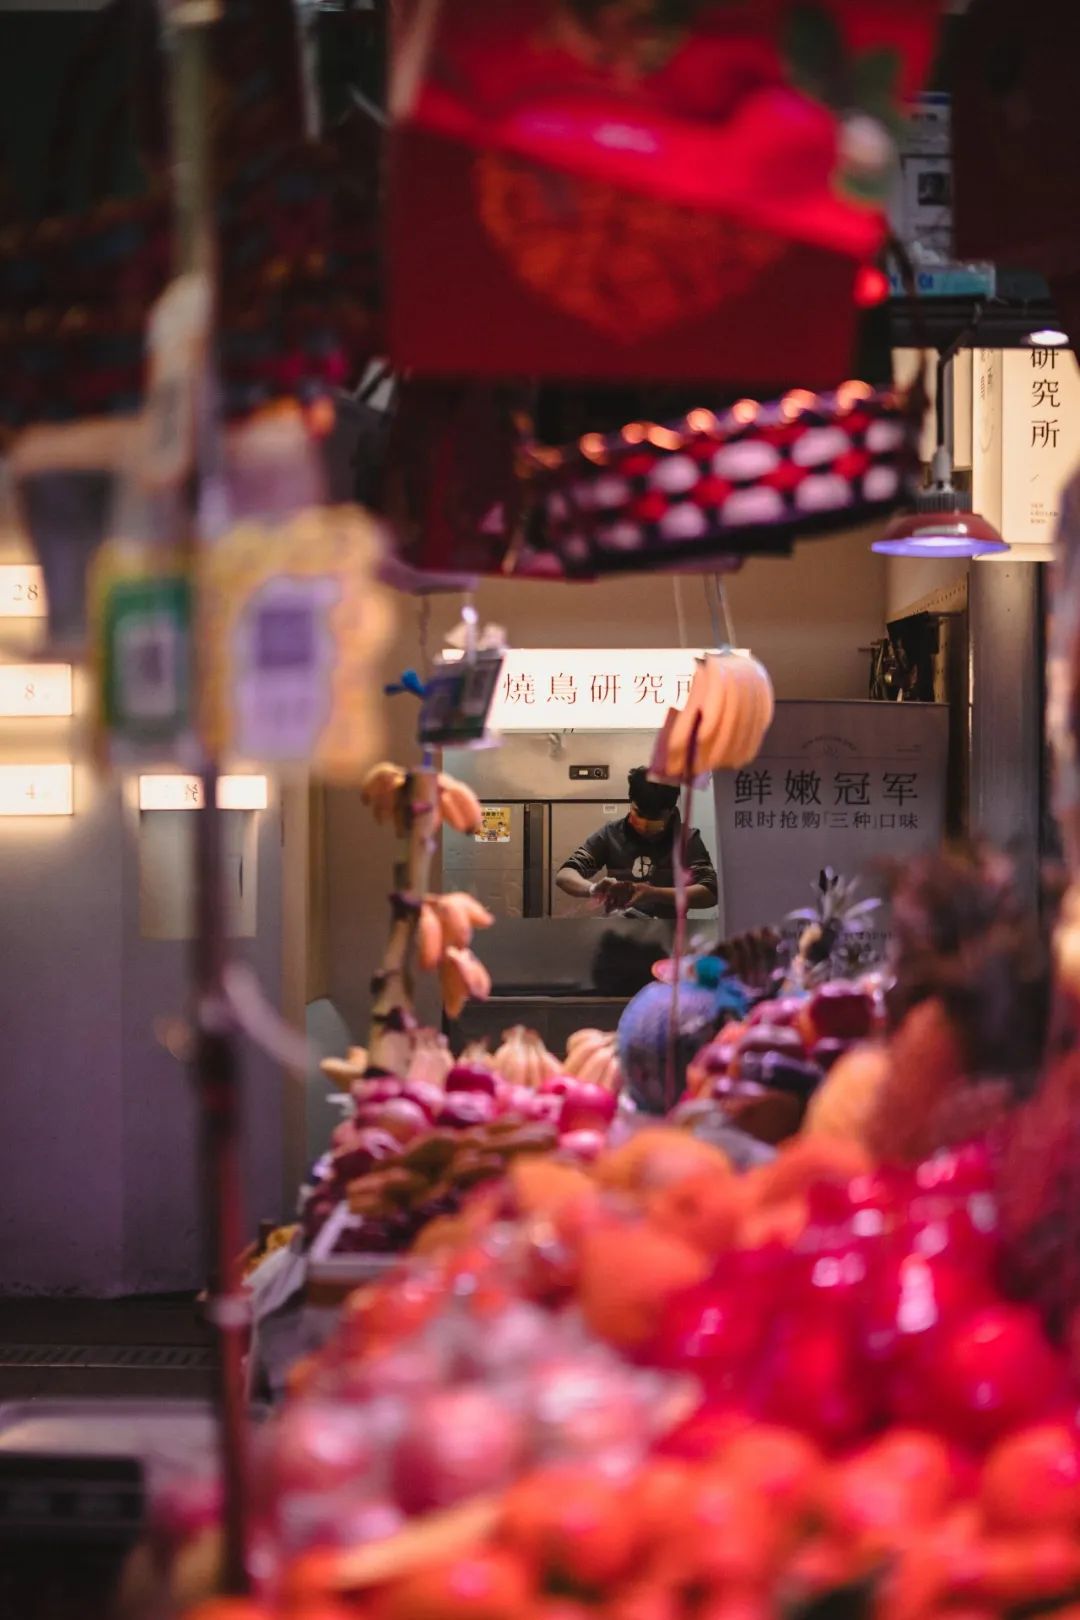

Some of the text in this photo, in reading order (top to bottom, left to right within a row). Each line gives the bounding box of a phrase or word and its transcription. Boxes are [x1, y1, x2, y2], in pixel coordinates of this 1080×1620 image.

[1030, 348, 1061, 448] 研究所
[734, 769, 918, 807] 鲜嫩冠军
